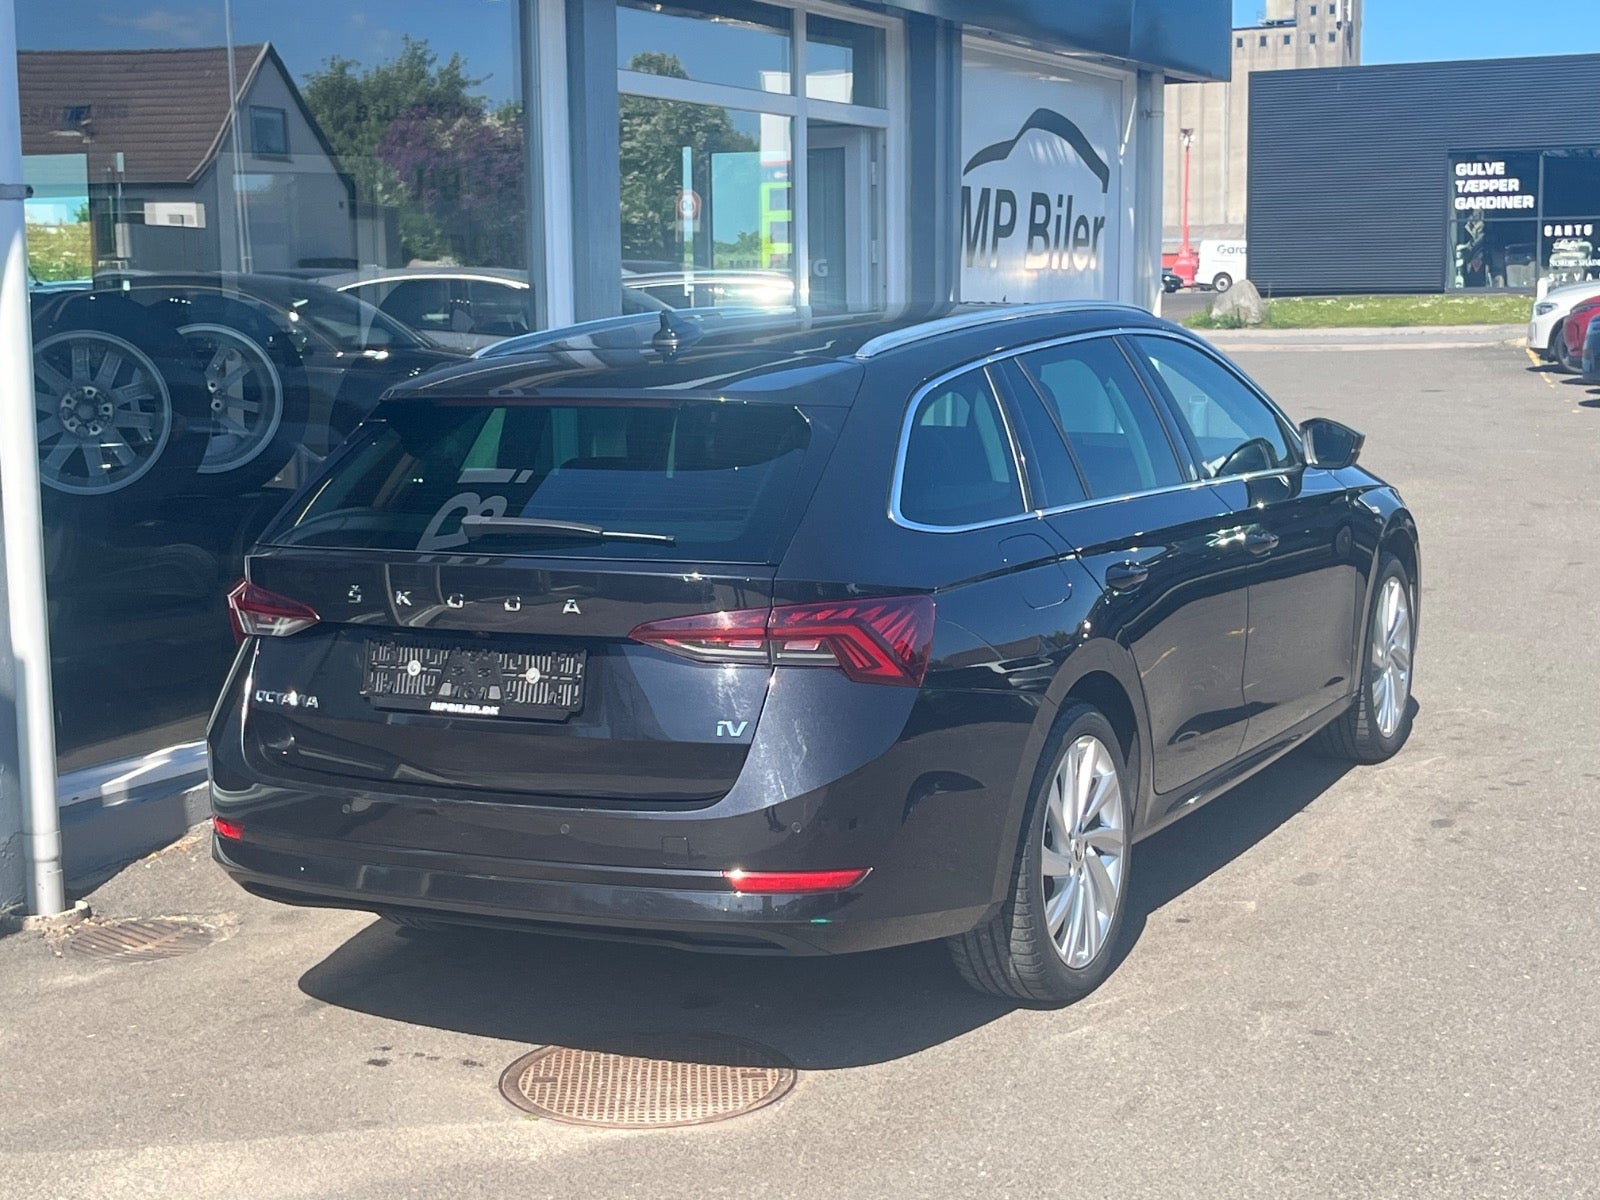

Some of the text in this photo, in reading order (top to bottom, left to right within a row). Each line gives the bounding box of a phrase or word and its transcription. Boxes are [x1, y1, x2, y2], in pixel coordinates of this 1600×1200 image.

[1455, 162, 1505, 176] GULVE
[1455, 178, 1519, 193] TÆPPER
[1454, 195, 1535, 210] GARDINER
[961, 186, 1106, 270] MP Biler
